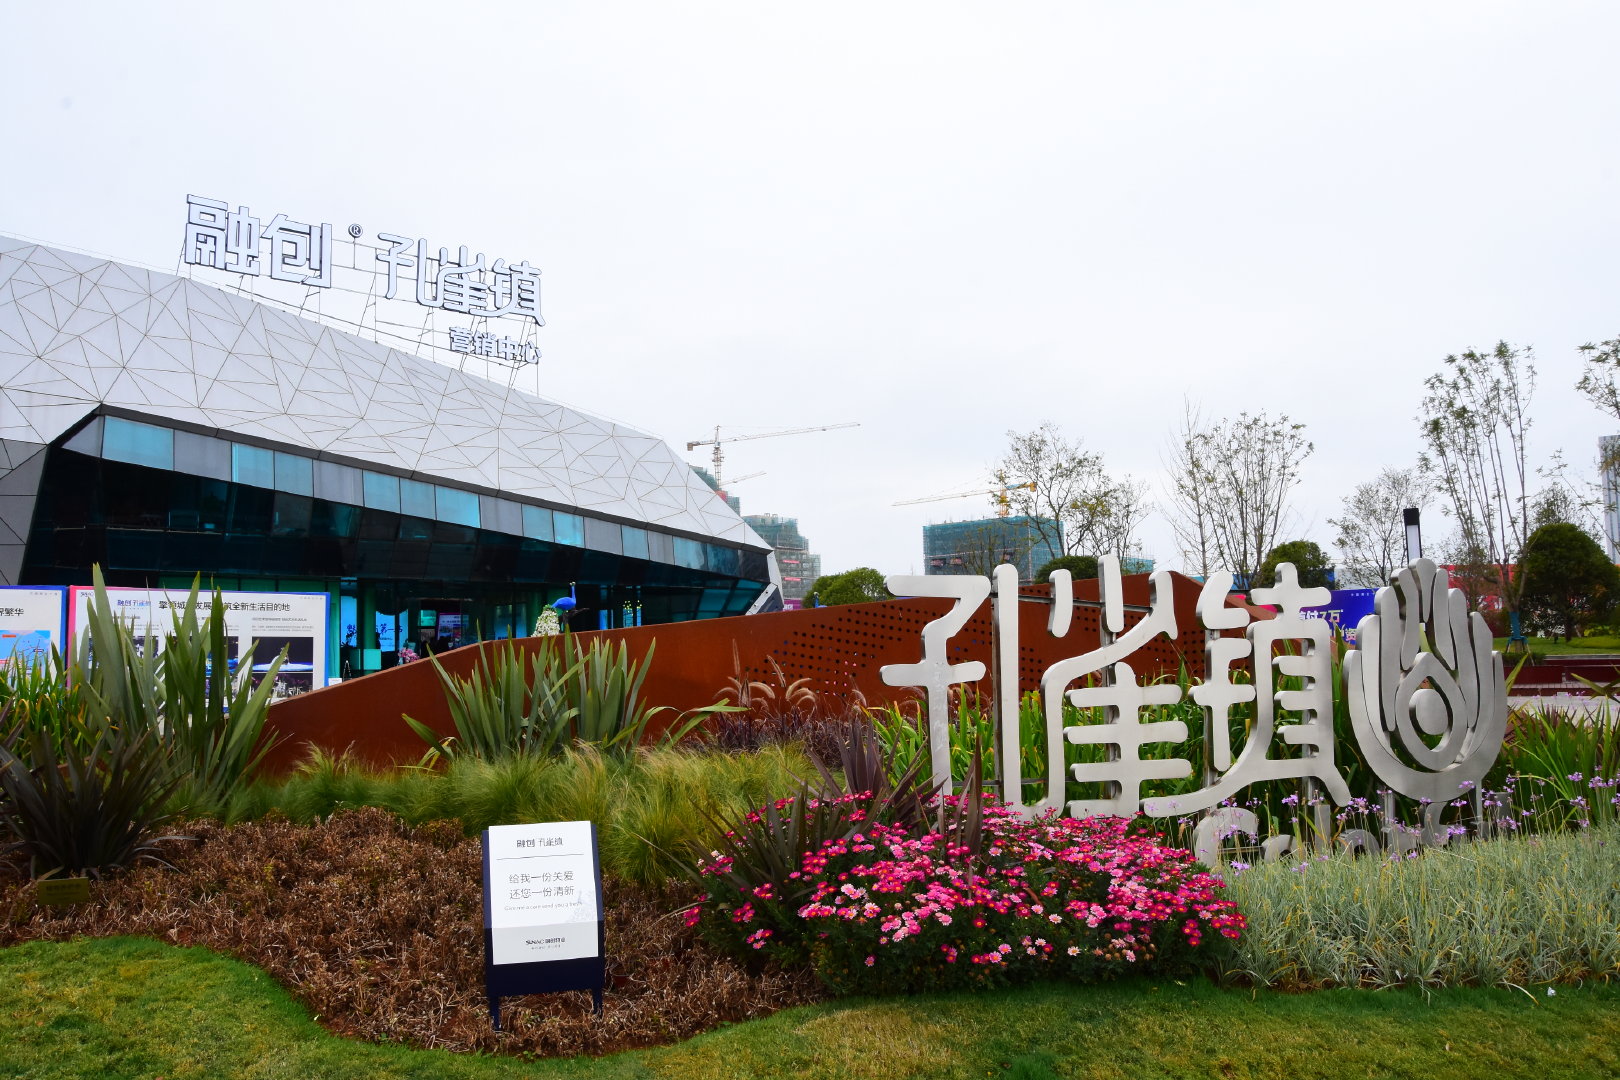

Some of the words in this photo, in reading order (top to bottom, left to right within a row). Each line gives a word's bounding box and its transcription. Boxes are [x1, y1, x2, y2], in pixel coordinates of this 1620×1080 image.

[185, 193, 333, 288] 融创
[449, 326, 542, 365] 营销中心
[516, 838, 535, 848] 融创
[509, 871, 574, 884] 给我一份关爱
[510, 886, 574, 900] 还您一份清新
